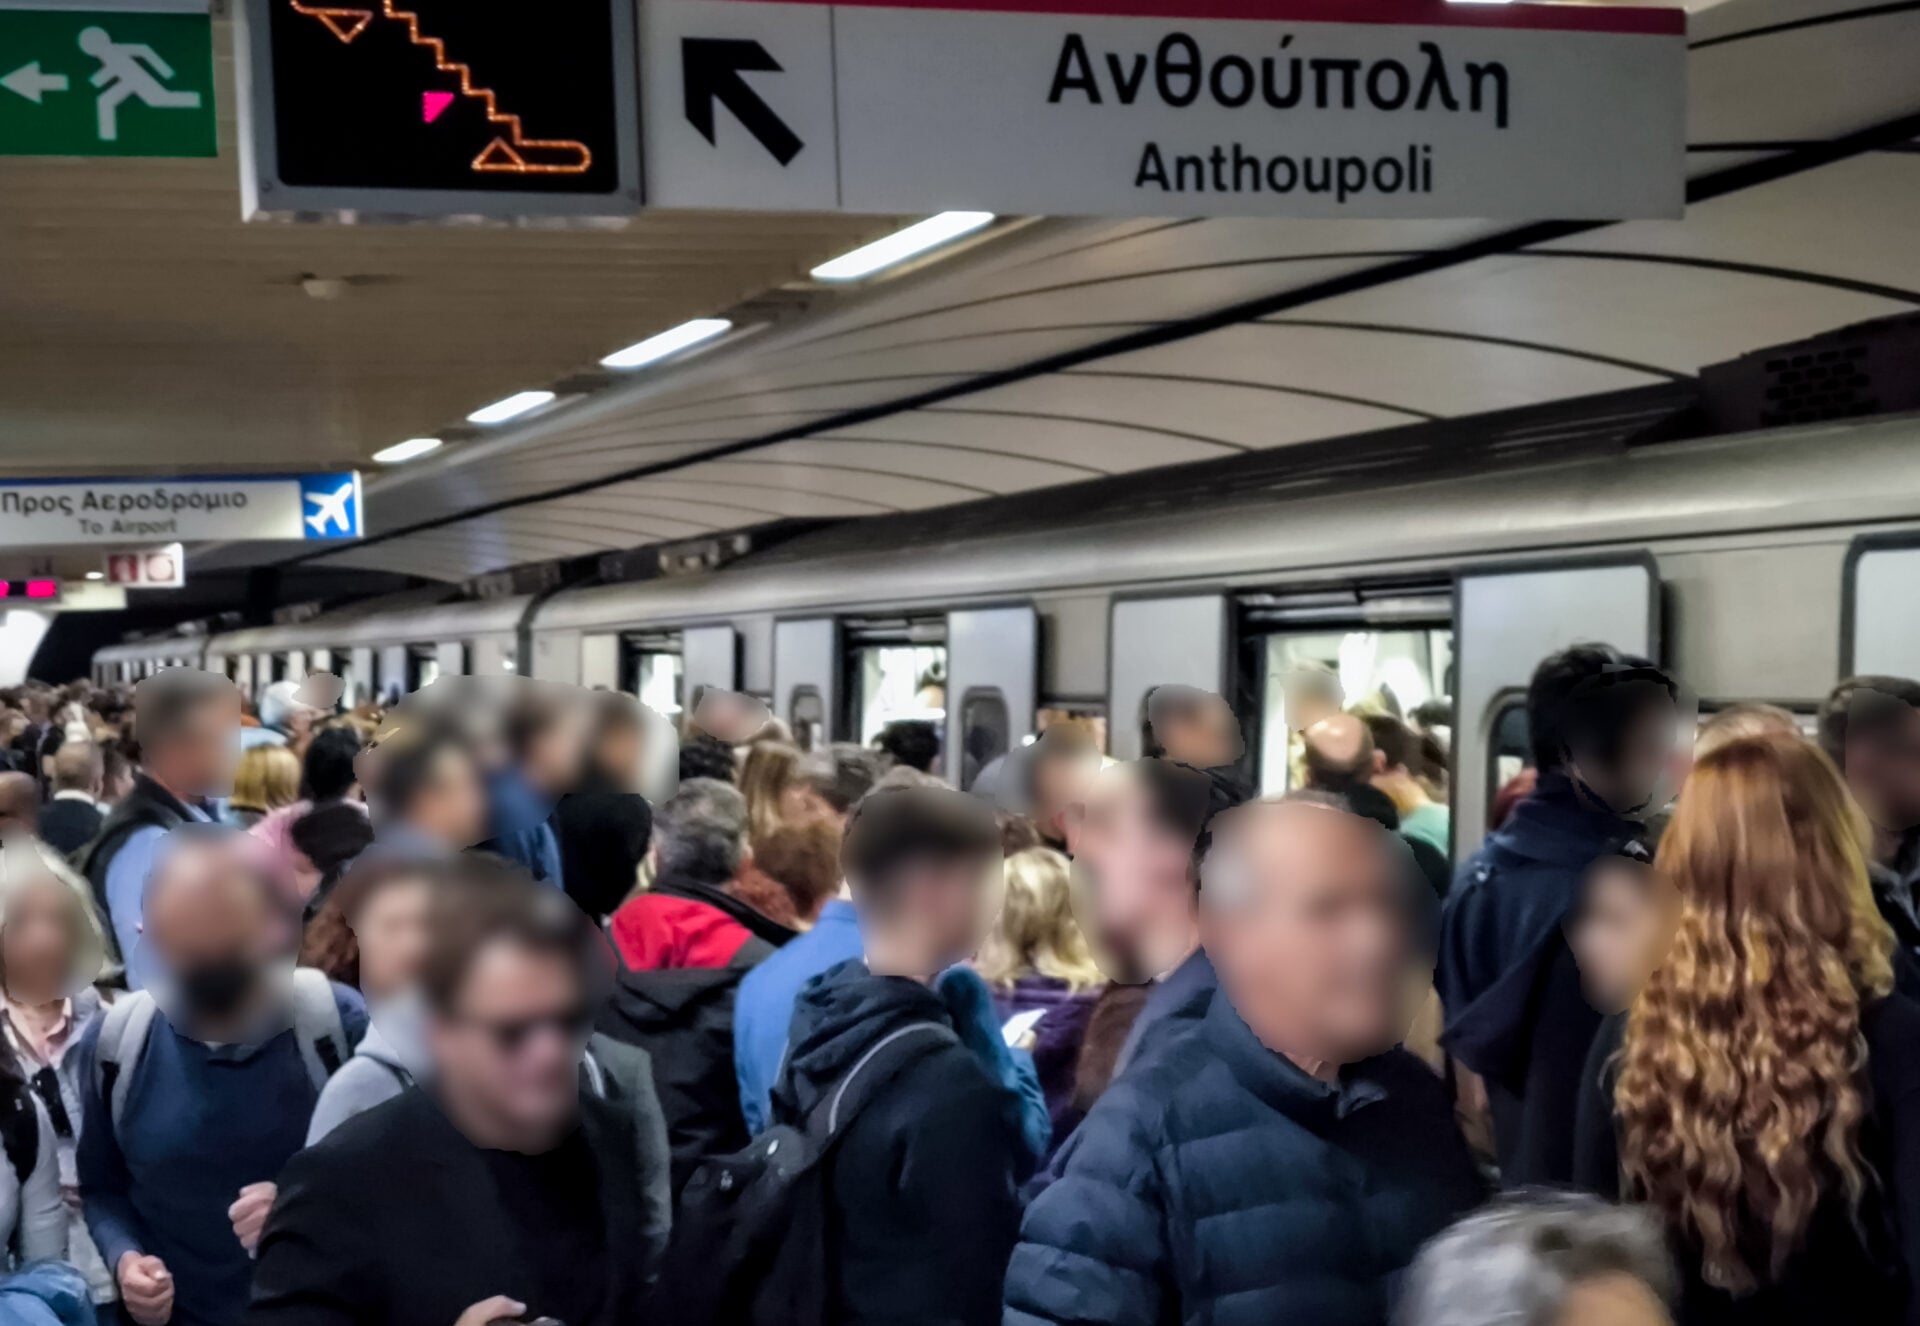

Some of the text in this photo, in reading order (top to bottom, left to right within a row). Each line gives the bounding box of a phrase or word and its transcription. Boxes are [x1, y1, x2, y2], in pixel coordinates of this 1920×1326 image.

[1047, 32, 1509, 128] Ανθούπολη
[1134, 142, 1432, 203] Anthoupoli
[2, 488, 248, 515] Προς Αεροδρόμιο
[79, 517, 178, 535] To Airport
